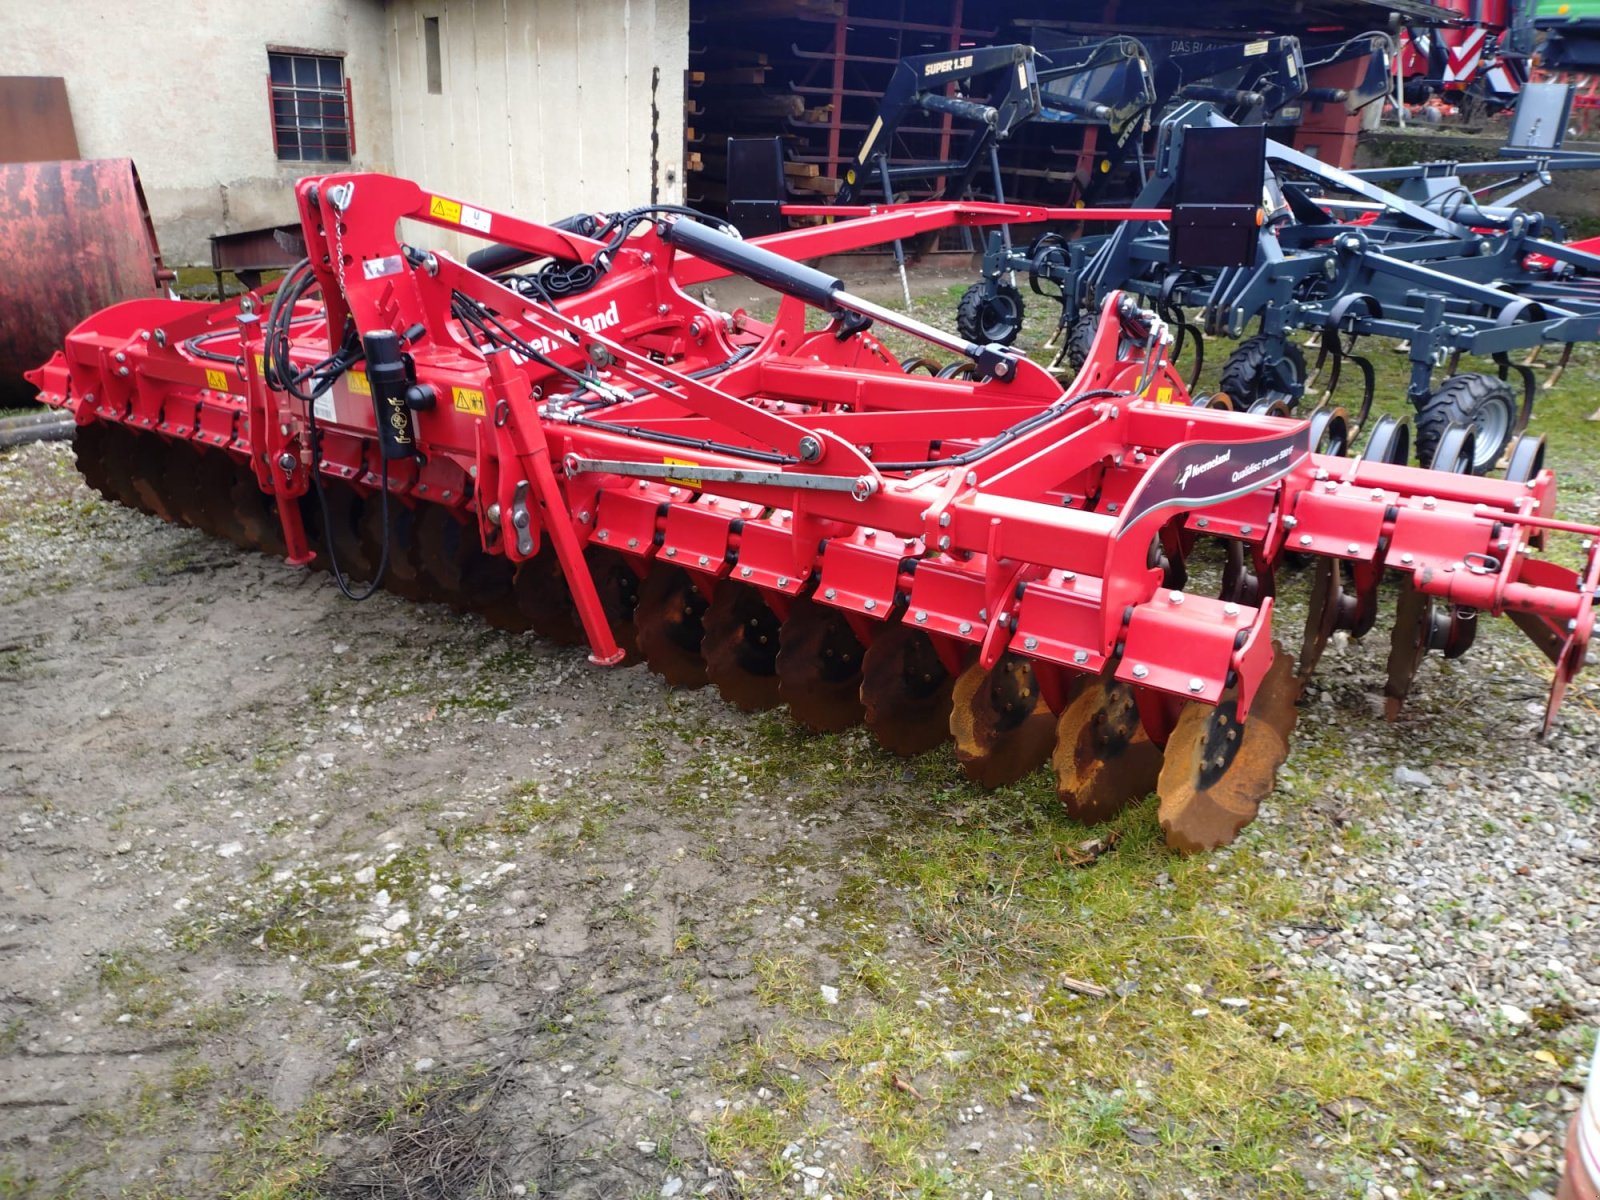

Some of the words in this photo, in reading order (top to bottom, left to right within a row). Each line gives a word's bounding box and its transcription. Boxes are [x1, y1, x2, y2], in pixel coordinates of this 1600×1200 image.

[1171, 41, 1191, 53] DAS
[924, 59, 953, 76] SUPER
[1191, 449, 1231, 478] Kverneland
[1231, 461, 1261, 483] Qualidisc
